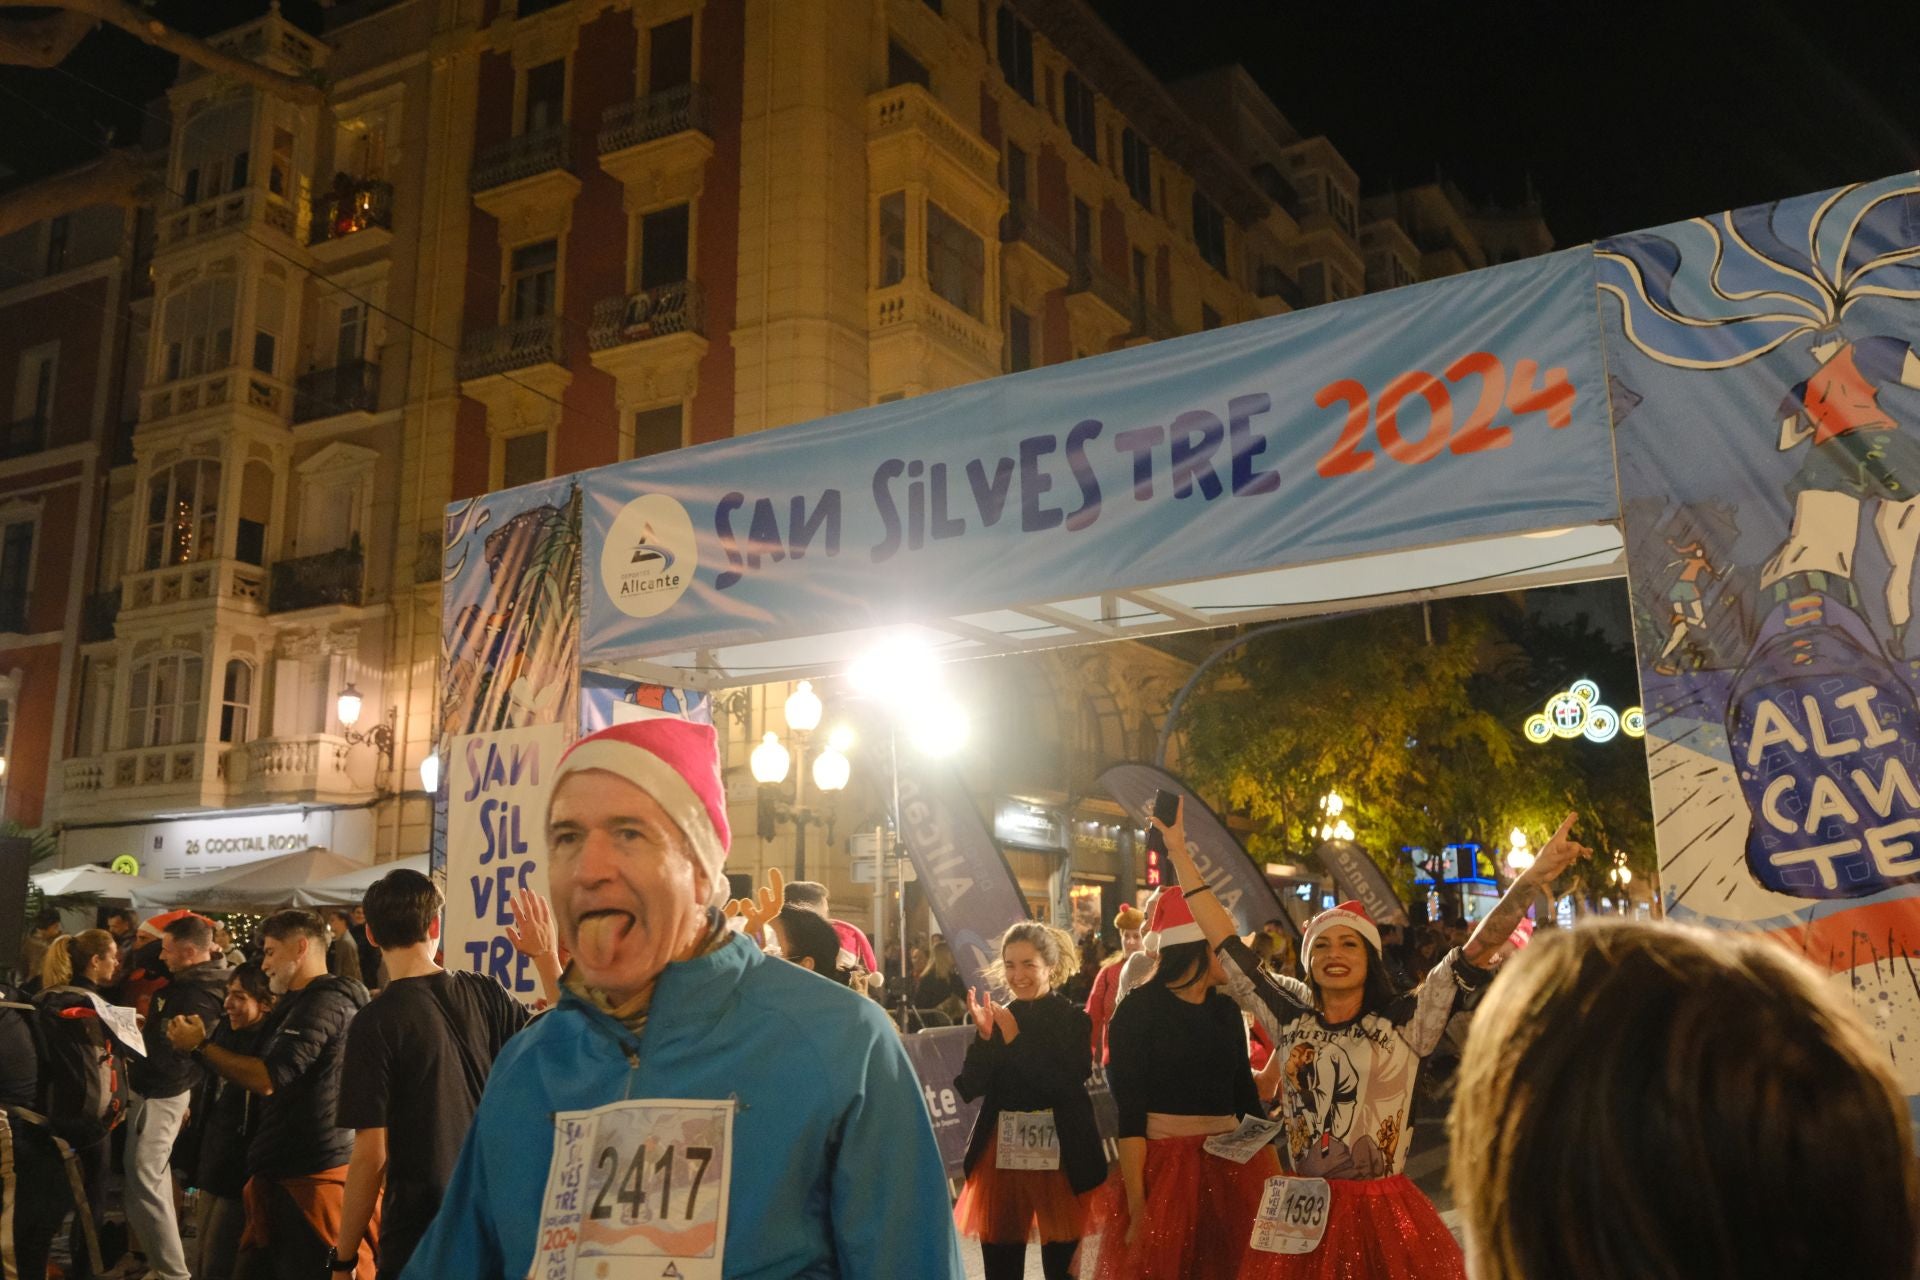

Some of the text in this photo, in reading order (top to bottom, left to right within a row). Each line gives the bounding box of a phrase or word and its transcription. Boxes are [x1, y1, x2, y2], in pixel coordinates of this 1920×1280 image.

[714, 488, 842, 590] SAN
[1314, 351, 1577, 478] 2024
[1747, 686, 1899, 766] ALI
[464, 737, 540, 802] SAN
[1762, 757, 1920, 834] CAN
[186, 834, 309, 855] 26 COCKTAIL ROOM
[1769, 818, 1920, 890] TE
[1020, 1125, 1055, 1148] 1517
[590, 1144, 713, 1220] 2417
[1284, 1193, 1325, 1226] 1593
[543, 1226, 577, 1252] 2024
